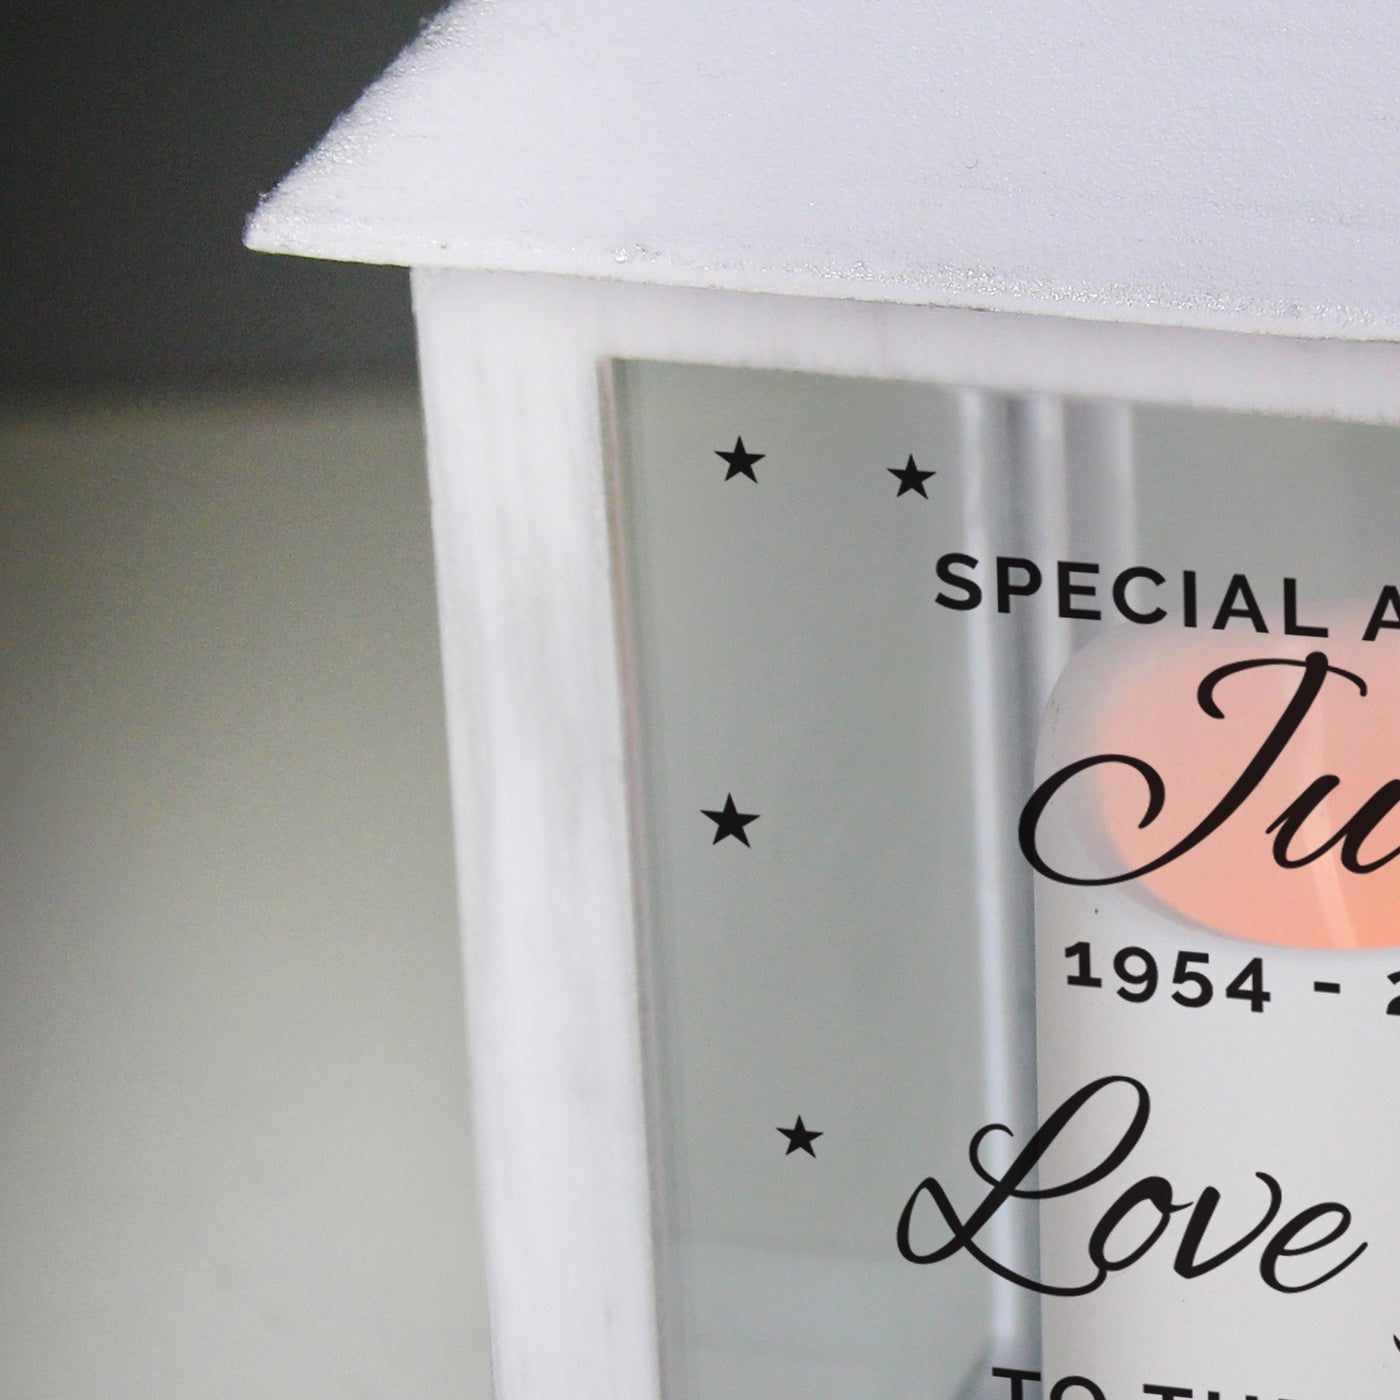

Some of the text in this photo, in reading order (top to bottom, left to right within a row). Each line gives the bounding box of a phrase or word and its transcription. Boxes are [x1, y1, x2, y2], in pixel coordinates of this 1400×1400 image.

[935, 552, 1329, 638] SPECIAL
[1064, 941, 1271, 1013] 1954
[1314, 981, 1341, 994] -
[897, 1075, 1368, 1297] Love
